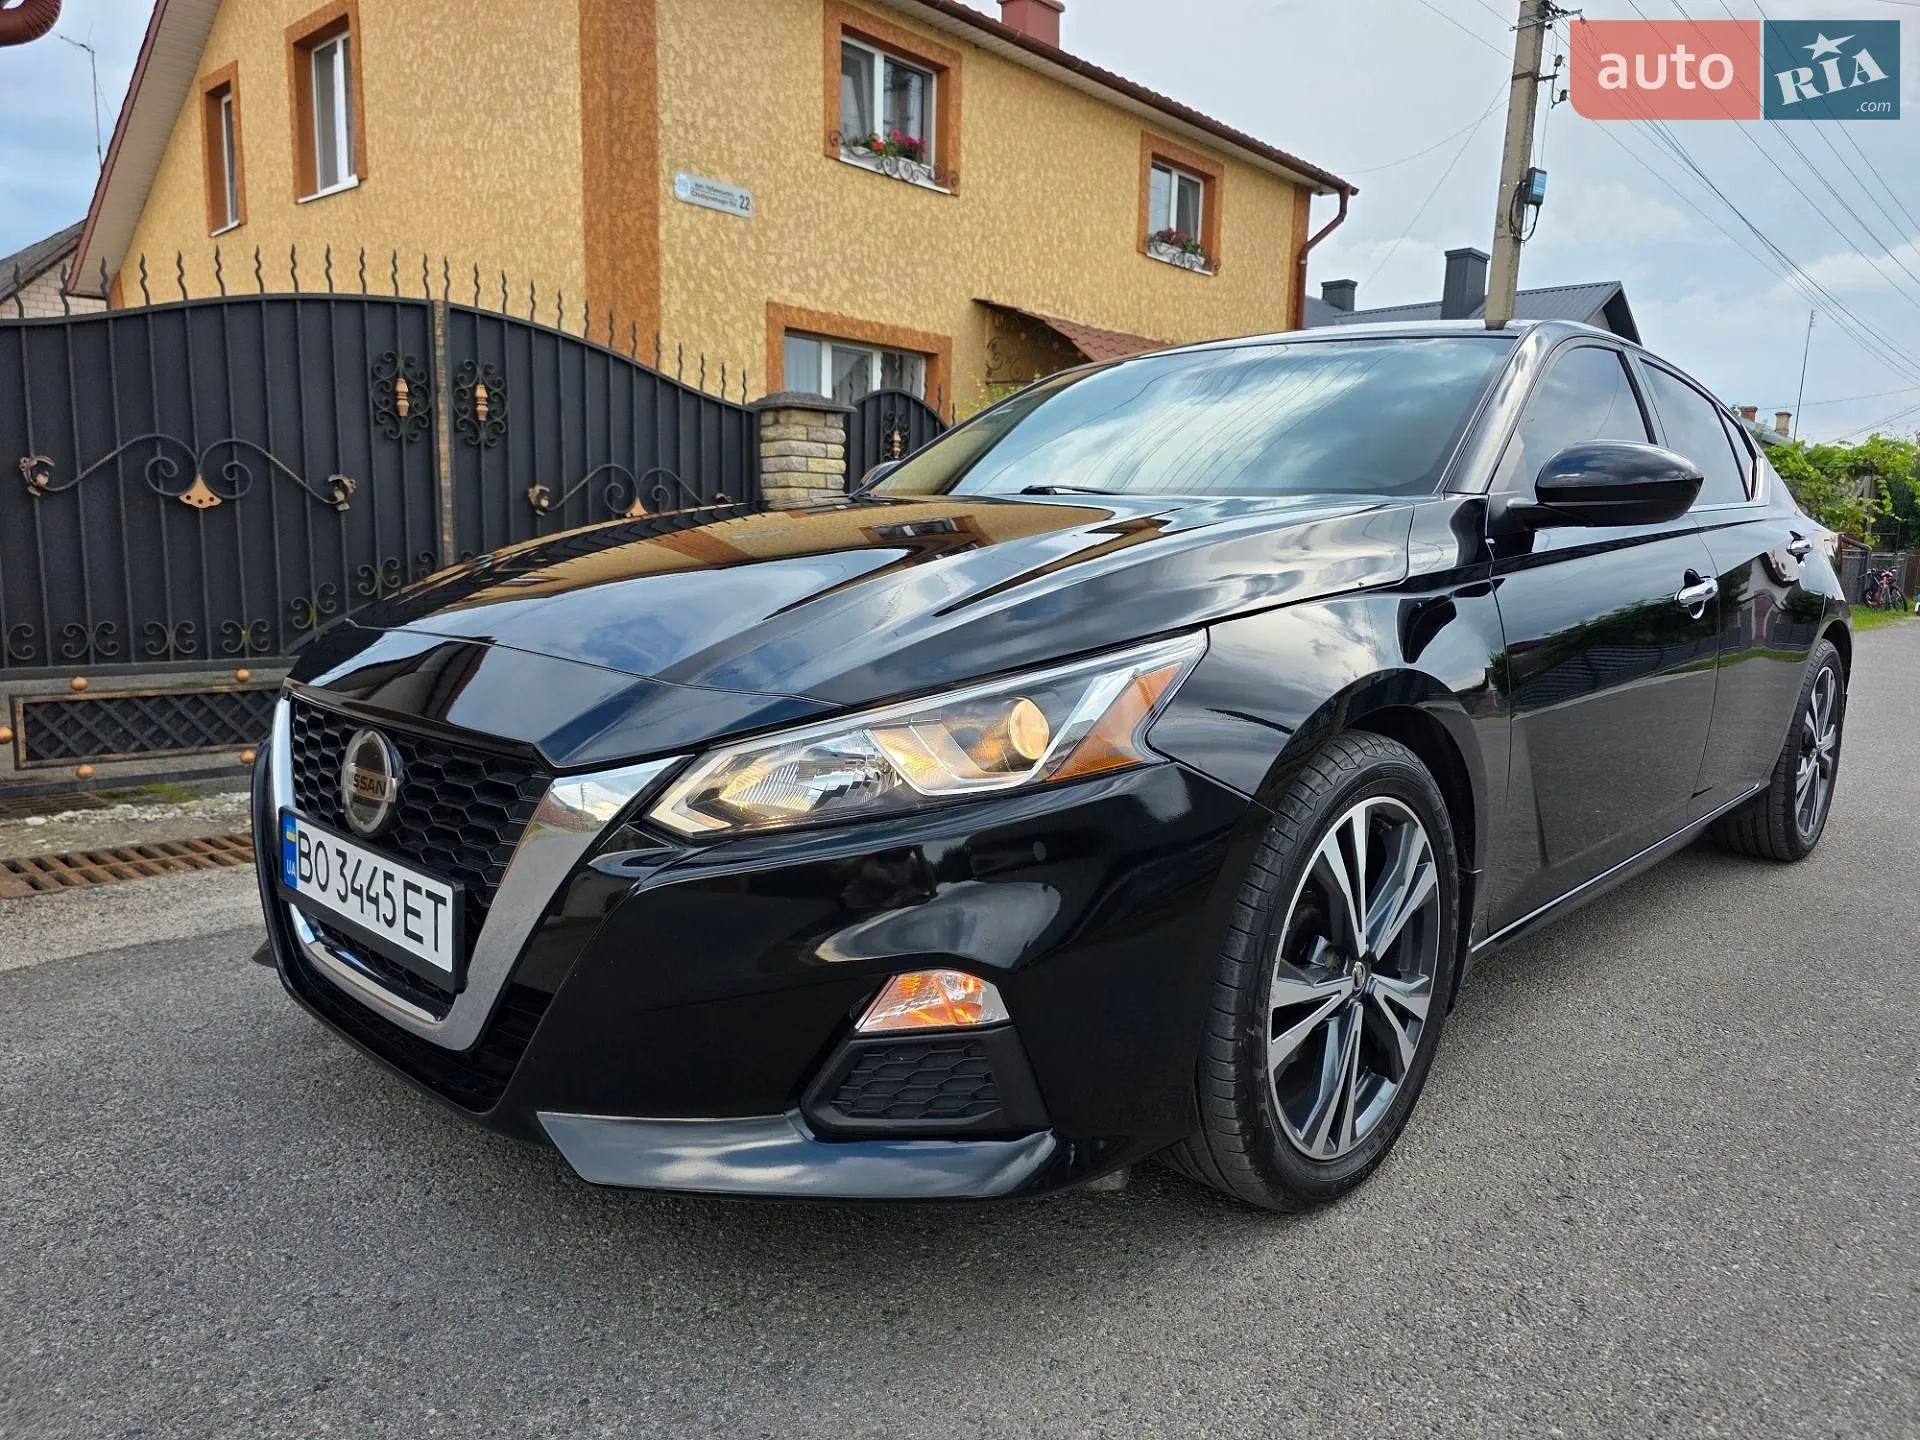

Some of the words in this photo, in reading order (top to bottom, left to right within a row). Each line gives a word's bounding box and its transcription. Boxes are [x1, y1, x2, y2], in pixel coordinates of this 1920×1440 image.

[739, 194, 750, 210] 22
[353, 773, 386, 795] SSAN
[286, 859, 296, 877] UA
[335, 848, 397, 928] 3445
[403, 879, 447, 952] ET
